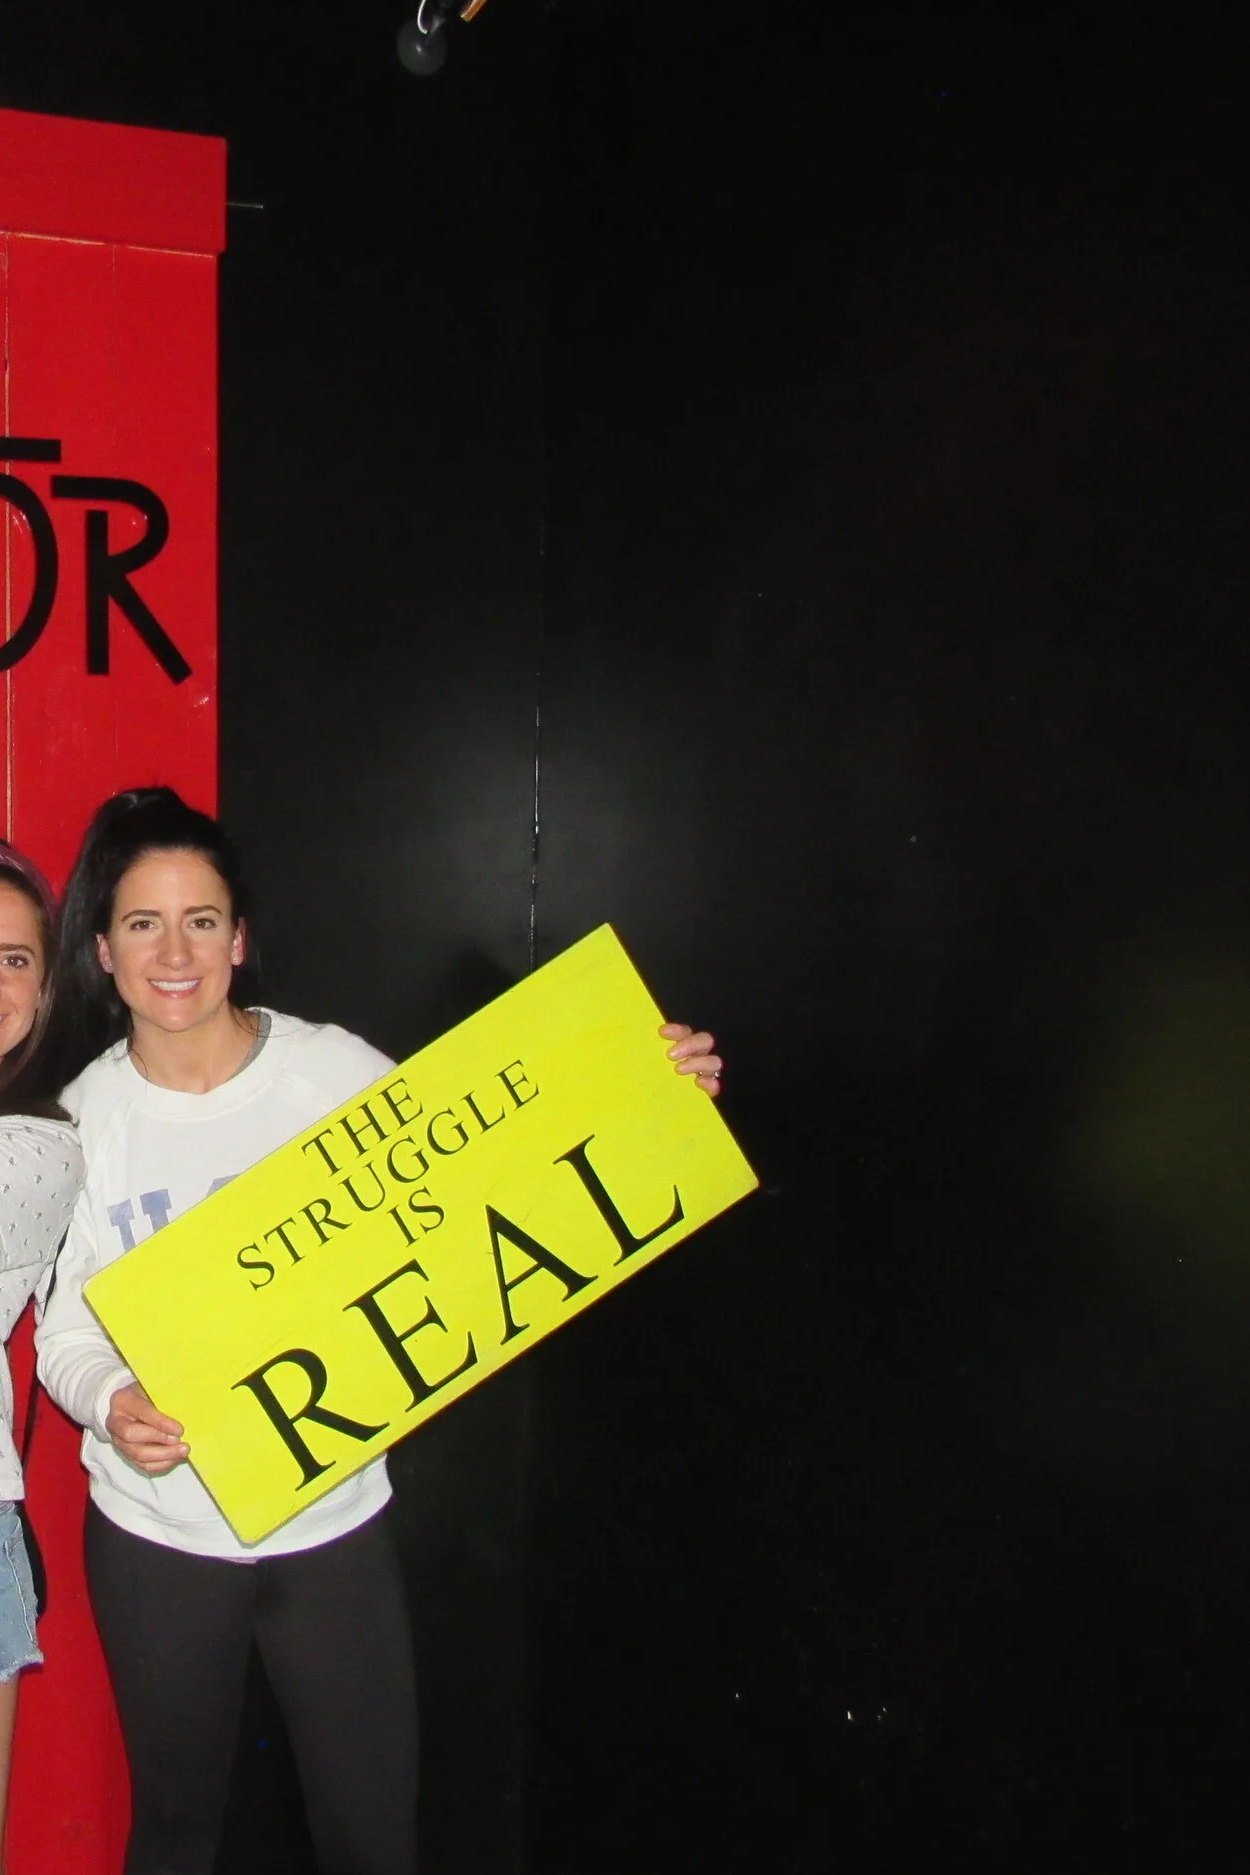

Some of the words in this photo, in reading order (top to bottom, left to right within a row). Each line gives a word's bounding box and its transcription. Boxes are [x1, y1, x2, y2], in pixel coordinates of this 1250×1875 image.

[236, 1059, 542, 1292] STRUGGLE
[302, 1077, 427, 1178] THE
[385, 1187, 445, 1247] IS
[230, 1133, 685, 1493] REAL
